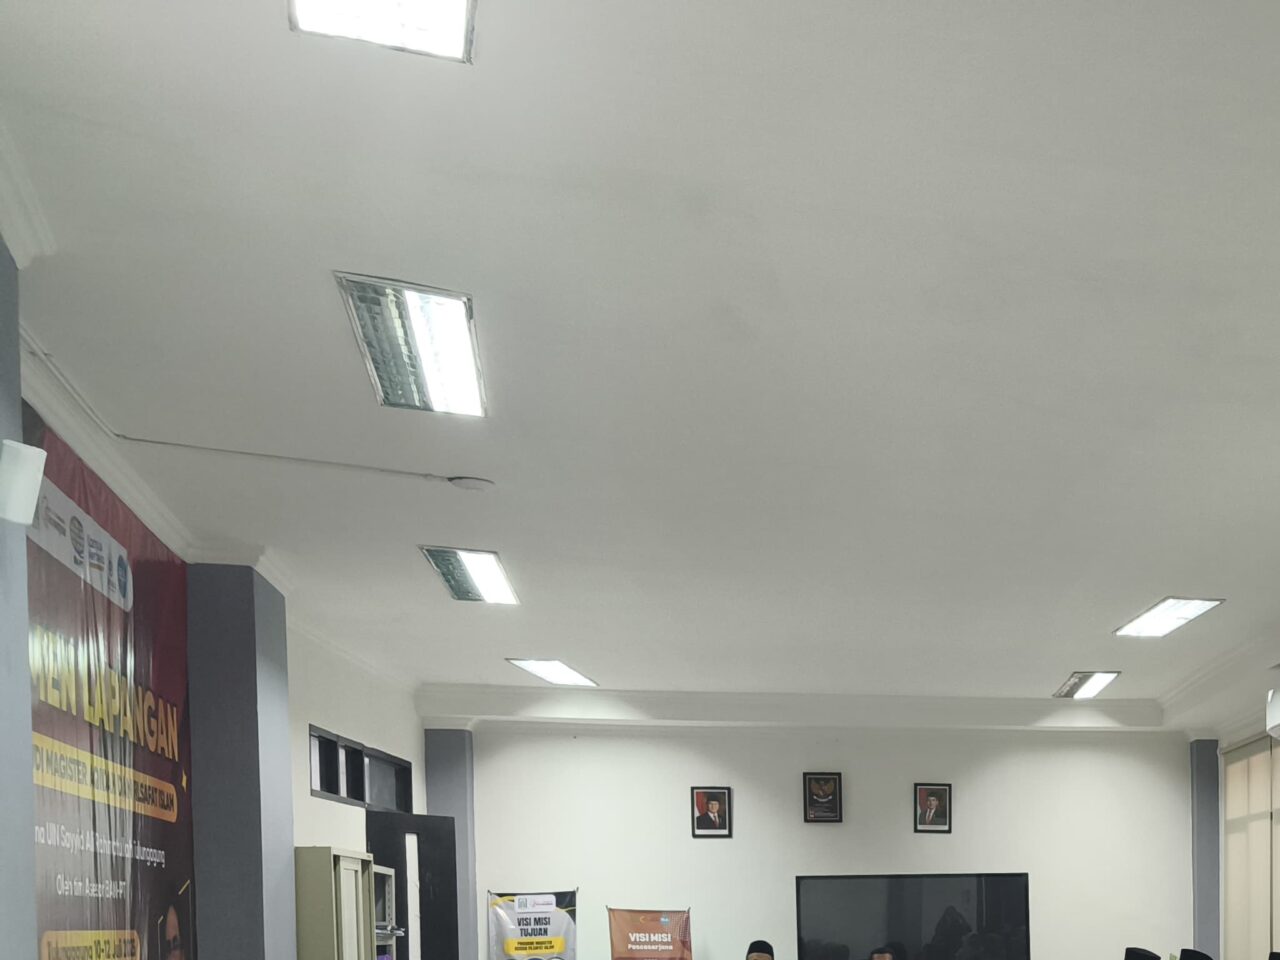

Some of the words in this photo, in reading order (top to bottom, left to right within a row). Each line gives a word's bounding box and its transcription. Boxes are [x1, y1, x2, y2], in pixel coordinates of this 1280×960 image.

[82, 650, 178, 762] LAPANGAN
[46, 749, 88, 786] MAGISTER
[159, 789, 175, 812] ISLAM
[46, 822, 60, 847] UIN
[517, 917, 532, 927] VISI
[533, 916, 551, 926] MISI
[520, 927, 548, 937] TUJUAN
[628, 932, 650, 942] VISI
[650, 932, 672, 942] MISI
[627, 943, 673, 951] Pascasarjana
